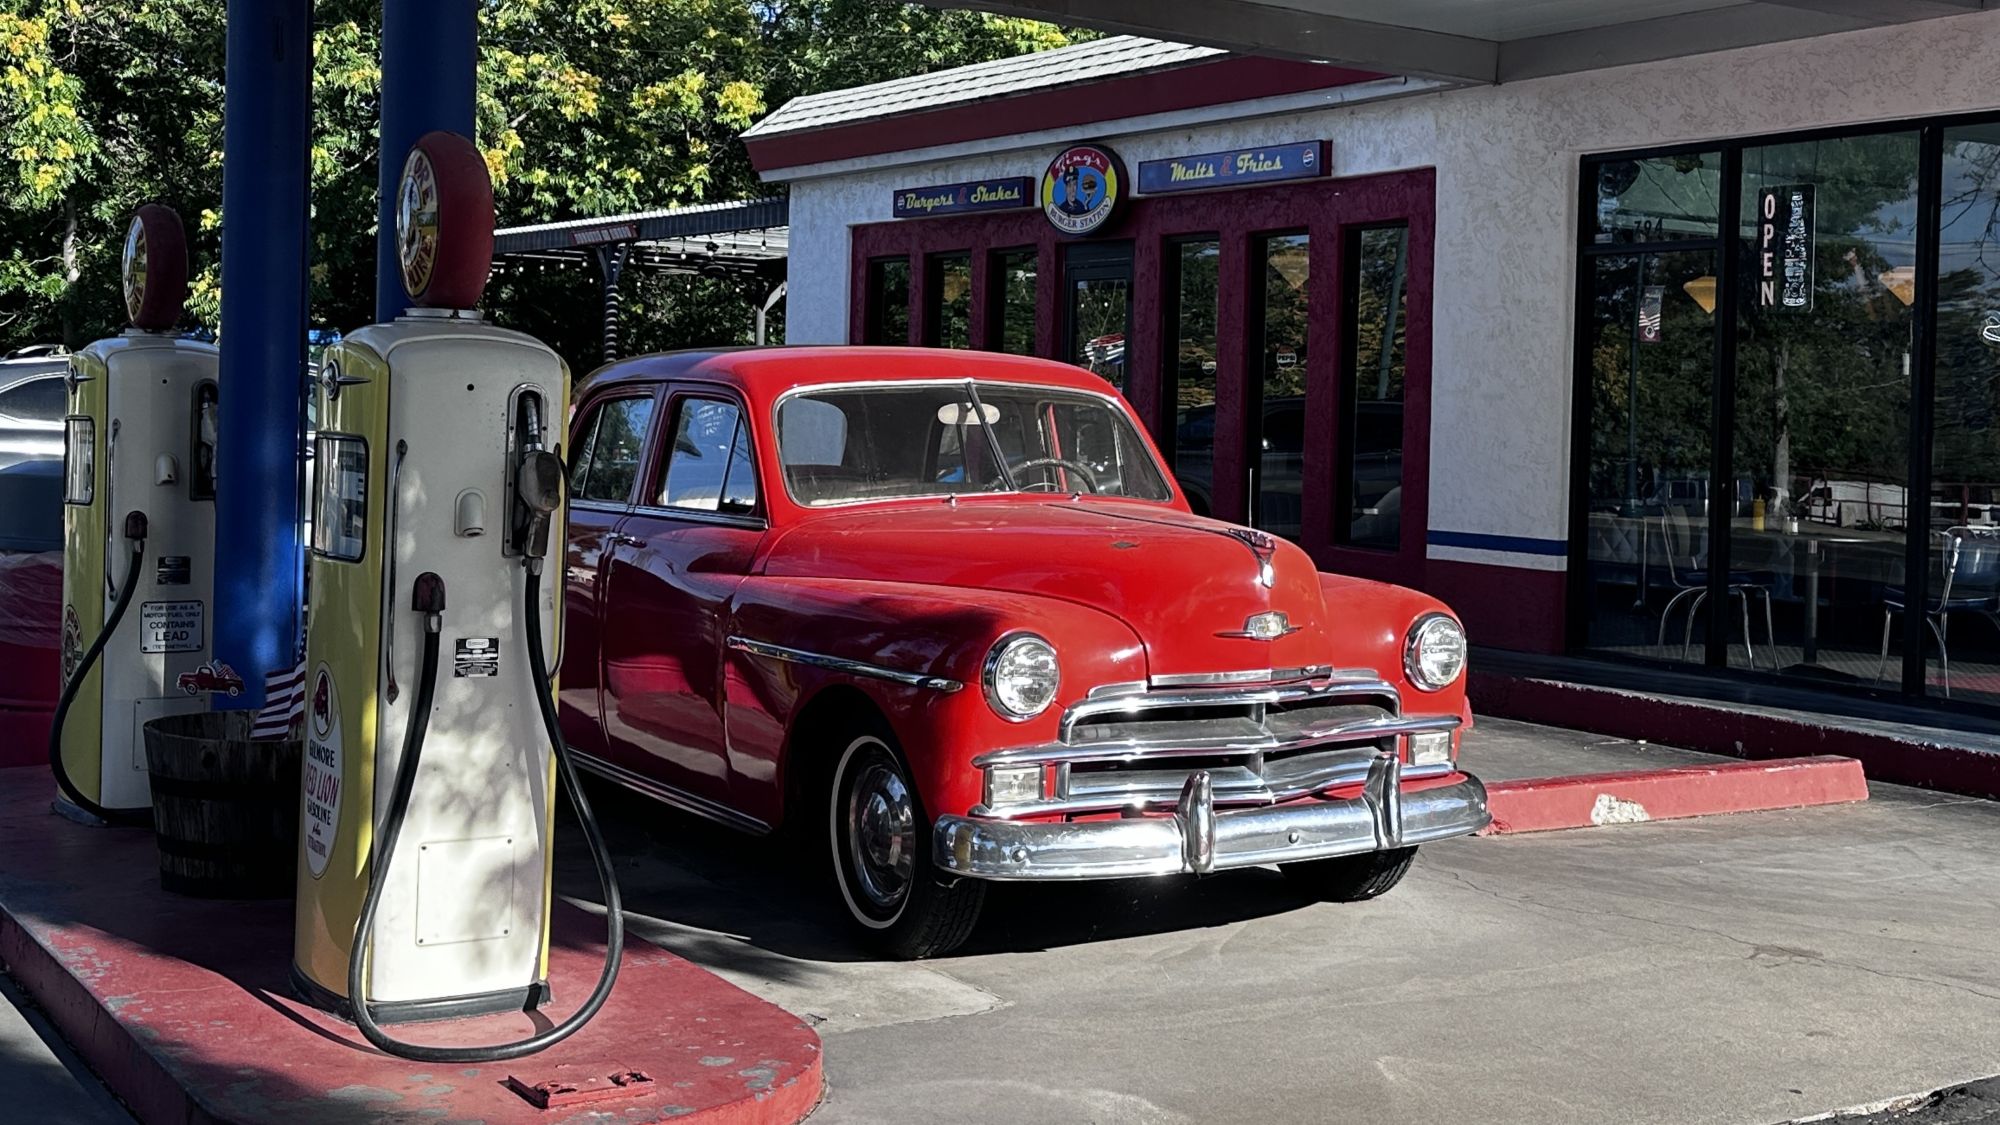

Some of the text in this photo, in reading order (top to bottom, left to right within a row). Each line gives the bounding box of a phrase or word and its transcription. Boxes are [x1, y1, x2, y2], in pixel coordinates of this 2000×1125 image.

[1170, 153, 1282, 182] Malts & Fries
[905, 185, 1020, 212] Burgers & Shakes
[1050, 204, 1109, 229] BURGER STATION
[1634, 216, 1664, 240] 794
[1761, 193, 1776, 306] OPEN
[149, 621, 195, 629] CONTAINS
[155, 631, 189, 641] LEAD
[309, 738, 335, 768] GILMORE
[305, 761, 340, 809] RED LION
[307, 797, 332, 826] GASOLINE
